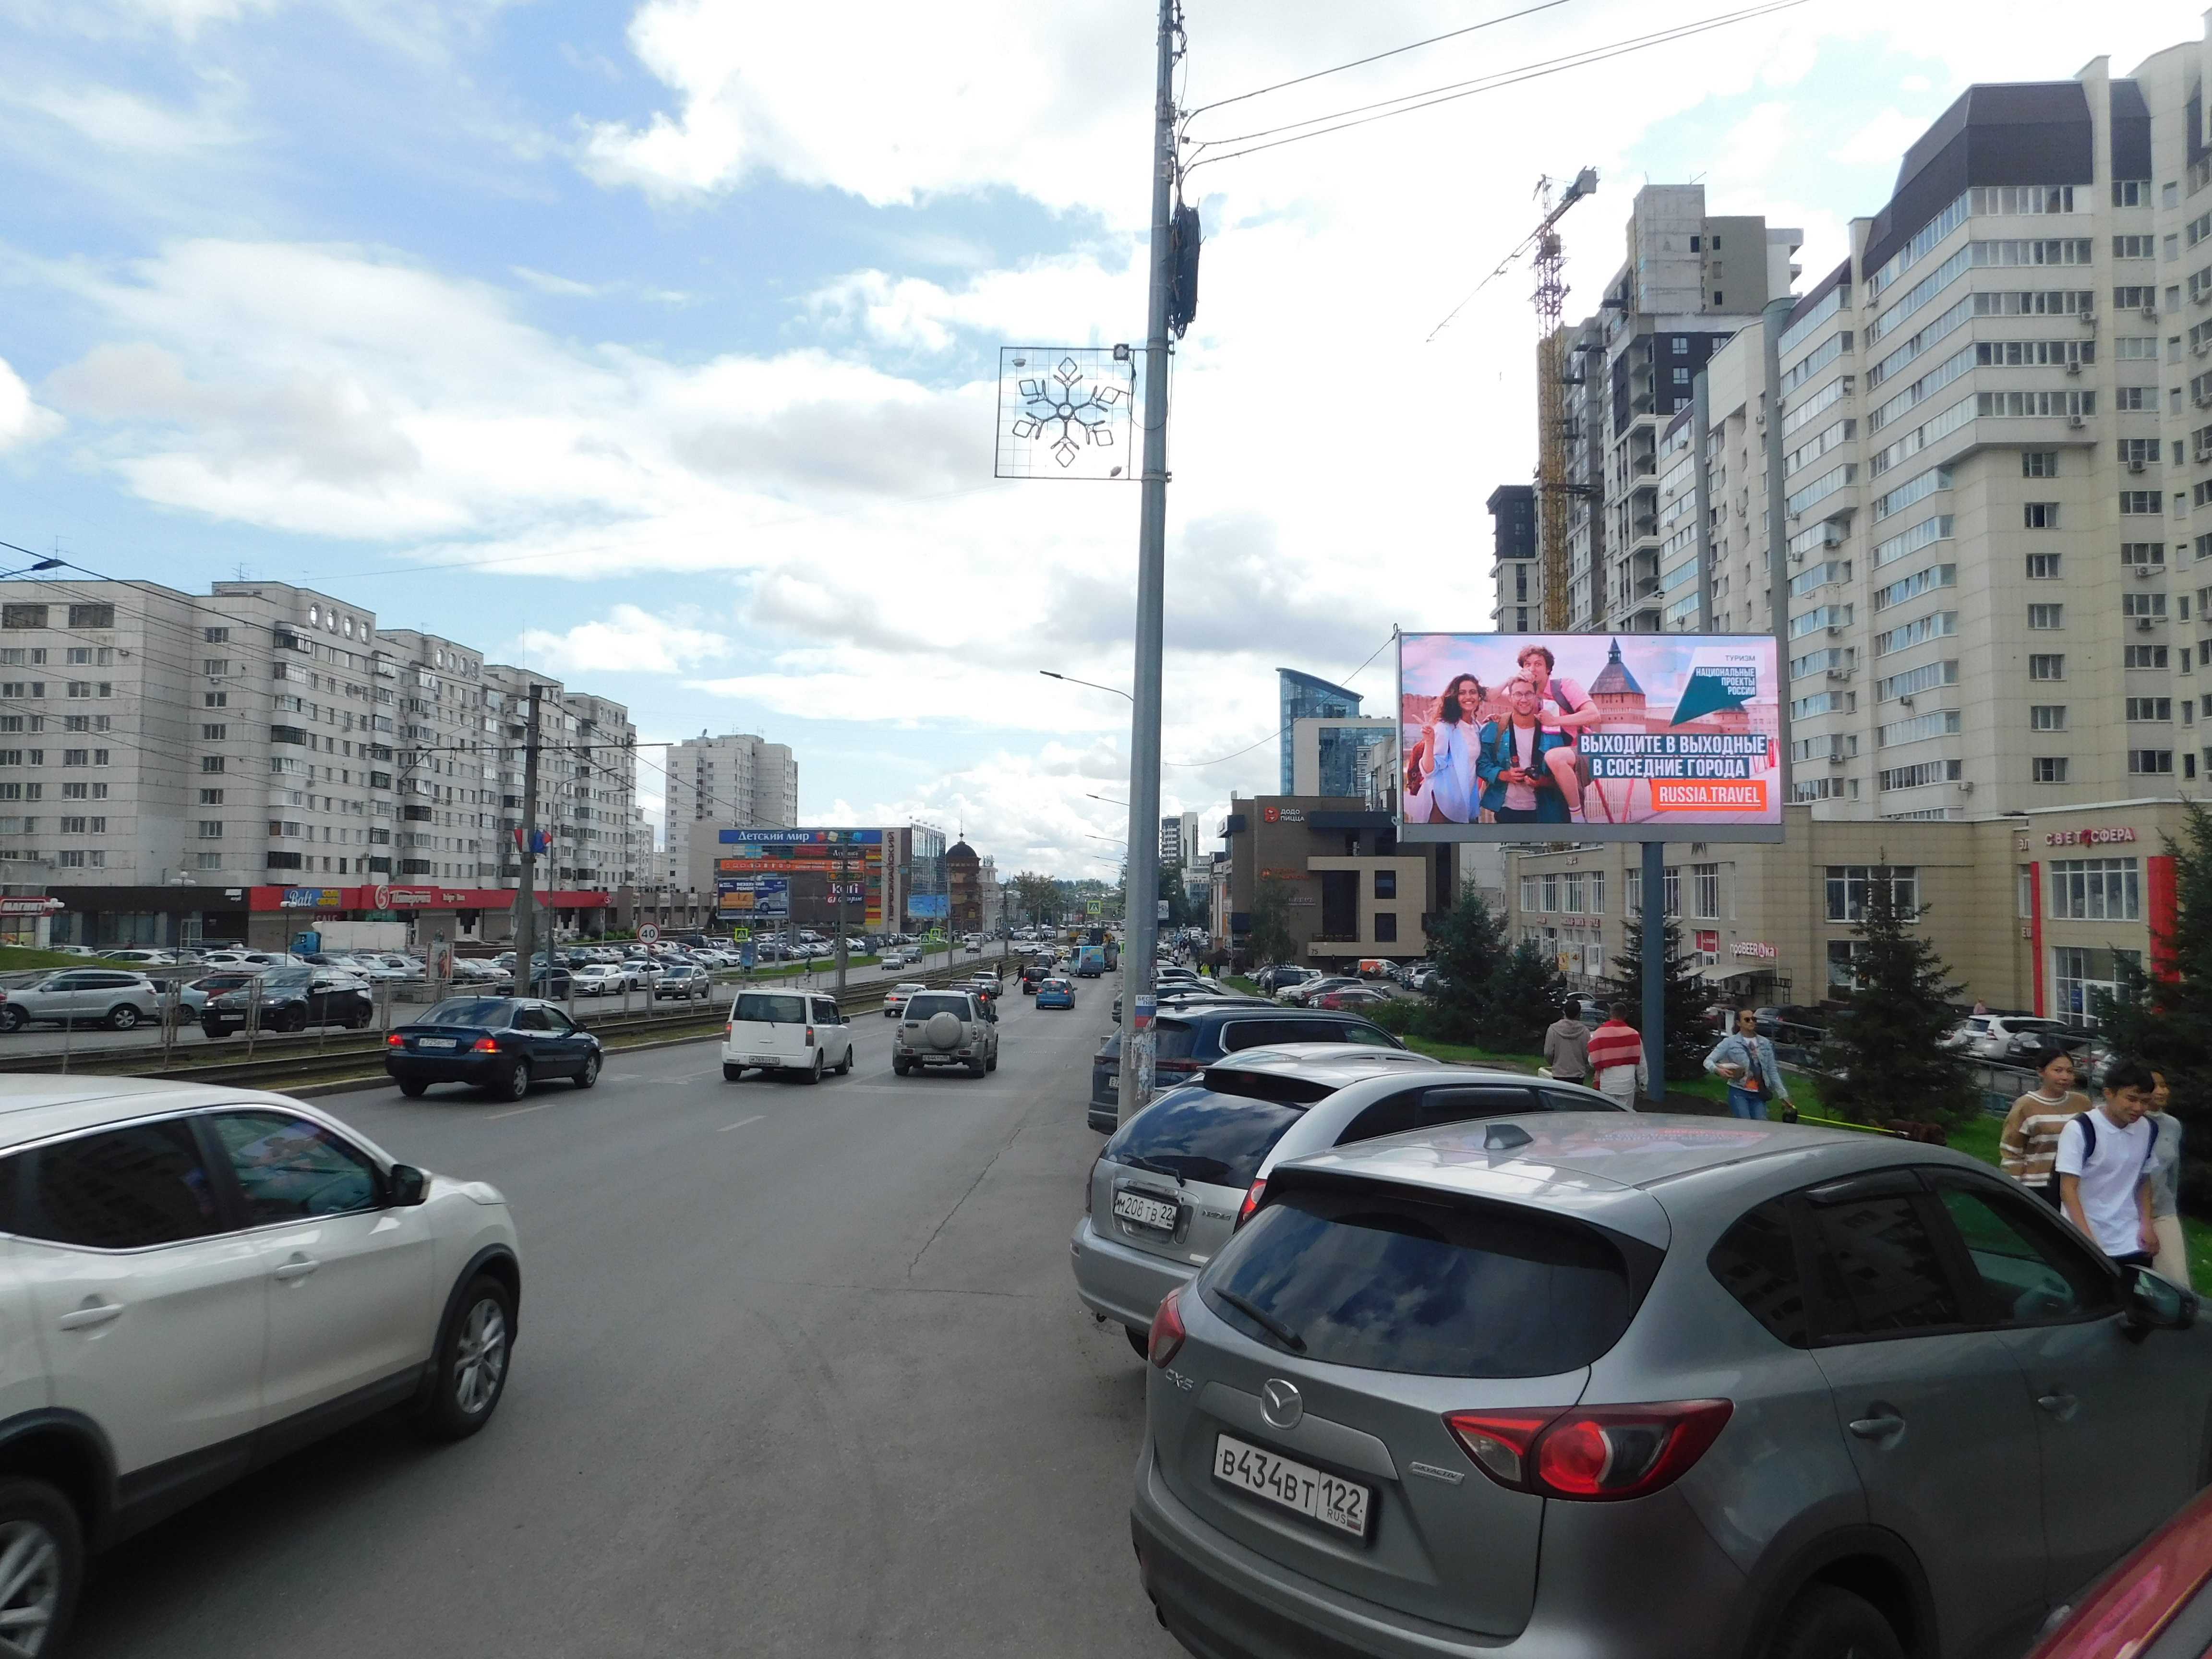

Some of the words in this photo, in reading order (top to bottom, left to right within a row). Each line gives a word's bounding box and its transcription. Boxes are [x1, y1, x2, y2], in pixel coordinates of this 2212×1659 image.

[1695, 668, 1755, 677] НАЦИОНАЛЬНЫЕ
[1721, 677, 1755, 686] ПРОЕКТЫ
[1728, 686, 1755, 695] РОССИИ
[1581, 735, 1662, 755] ВЫХОДИТЕ
[1666, 736, 1675, 753] В
[1680, 736, 1766, 755] ВЫХОДНЫЕ
[1593, 759, 1602, 776] В
[1606, 758, 1683, 778] СОСЕДНИЕ
[1687, 759, 1745, 778] ГОРОДА
[1659, 786, 1761, 803] RUSSIA.TRAVEL
[738, 831, 783, 841] Детский
[786, 833, 809, 842] мир
[641, 929, 655, 938] 40
[1166, 1368, 1194, 1390] CX-5
[1322, 1479, 1361, 1518] 122
[1326, 1509, 1347, 1525] RUS
